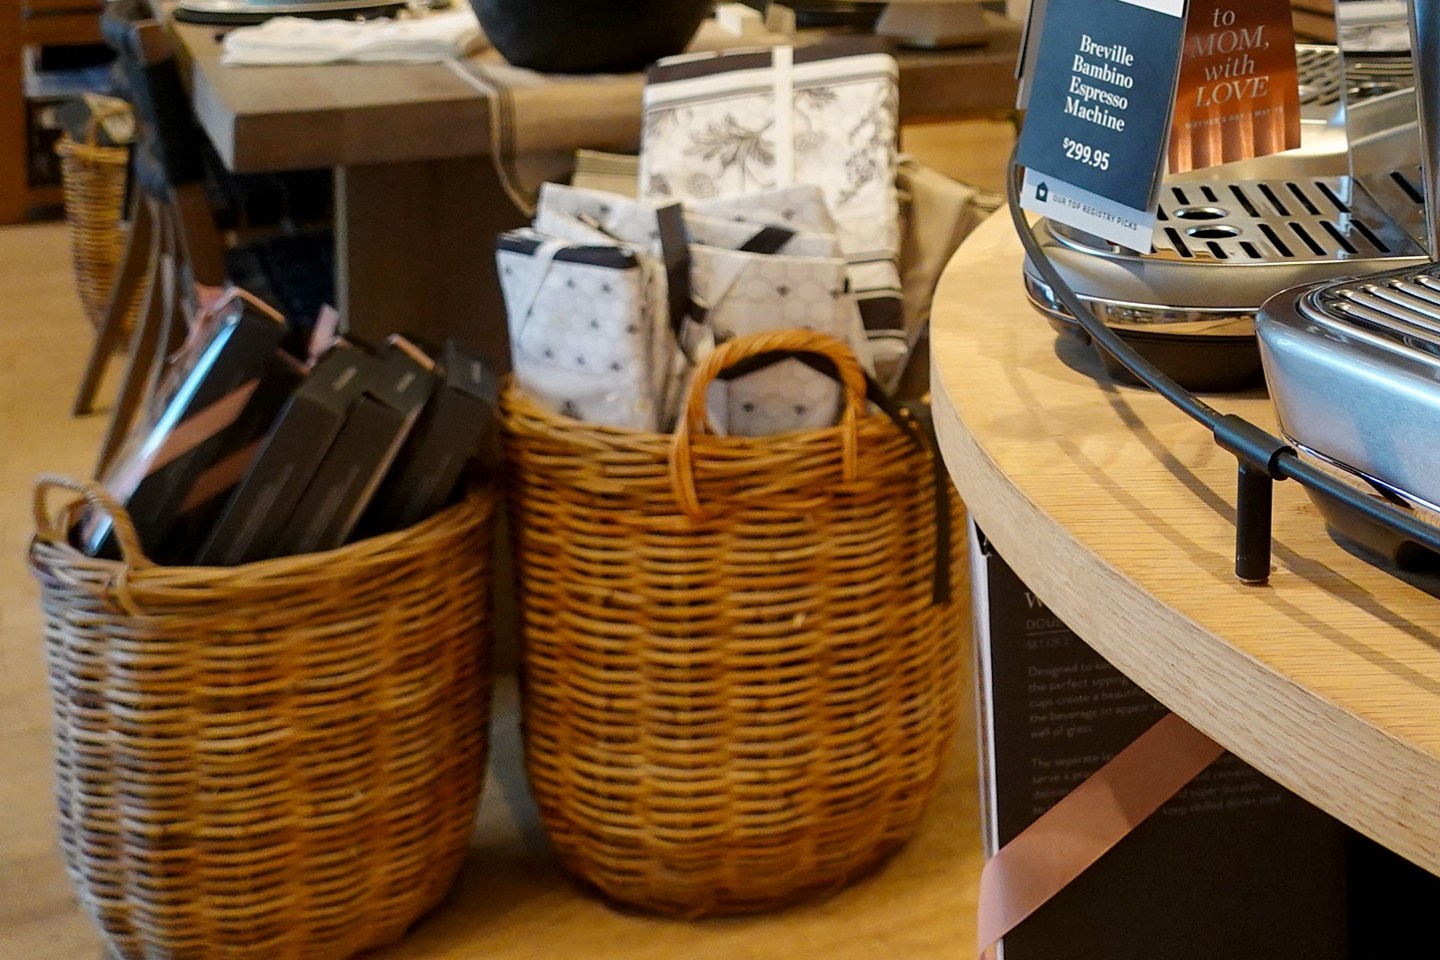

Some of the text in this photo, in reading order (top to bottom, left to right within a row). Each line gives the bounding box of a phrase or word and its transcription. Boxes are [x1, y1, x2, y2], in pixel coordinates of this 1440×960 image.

[1212, 8, 1235, 28] to
[1080, 34, 1134, 67] Breville
[1189, 25, 1270, 58] MOM,
[1072, 54, 1134, 89] Bambino
[1205, 54, 1254, 81] with
[1069, 75, 1128, 110] Espresso
[1196, 76, 1269, 107] LOVE
[1063, 96, 1125, 132] Machine
[1062, 137, 1110, 171] $299.95
[1052, 194, 1138, 231] OUR TOP REGISTRY PICKS
